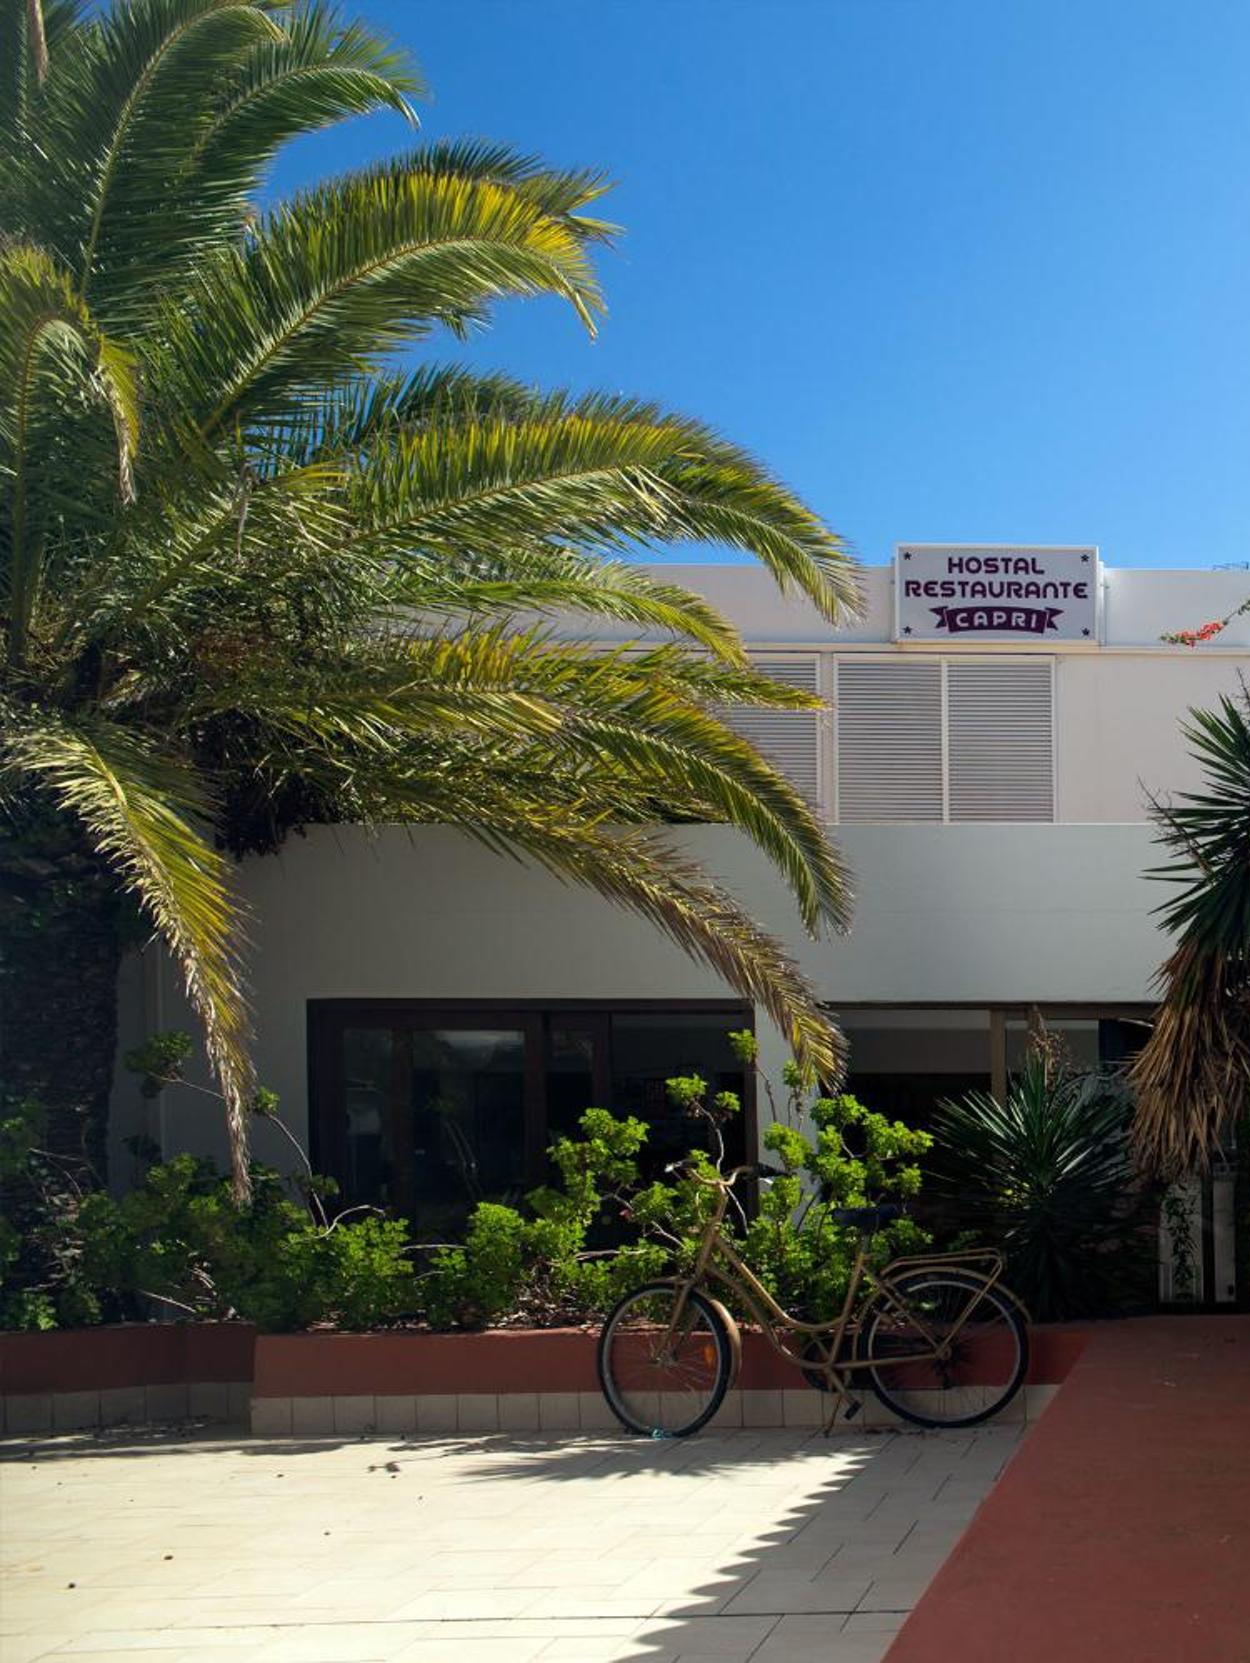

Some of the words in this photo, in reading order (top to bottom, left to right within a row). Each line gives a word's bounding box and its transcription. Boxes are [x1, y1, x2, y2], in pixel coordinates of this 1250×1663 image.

[947, 557, 1045, 575] HOSTAL
[904, 580, 1088, 599] RESTAURANTE
[956, 612, 1037, 629] CAPRI
